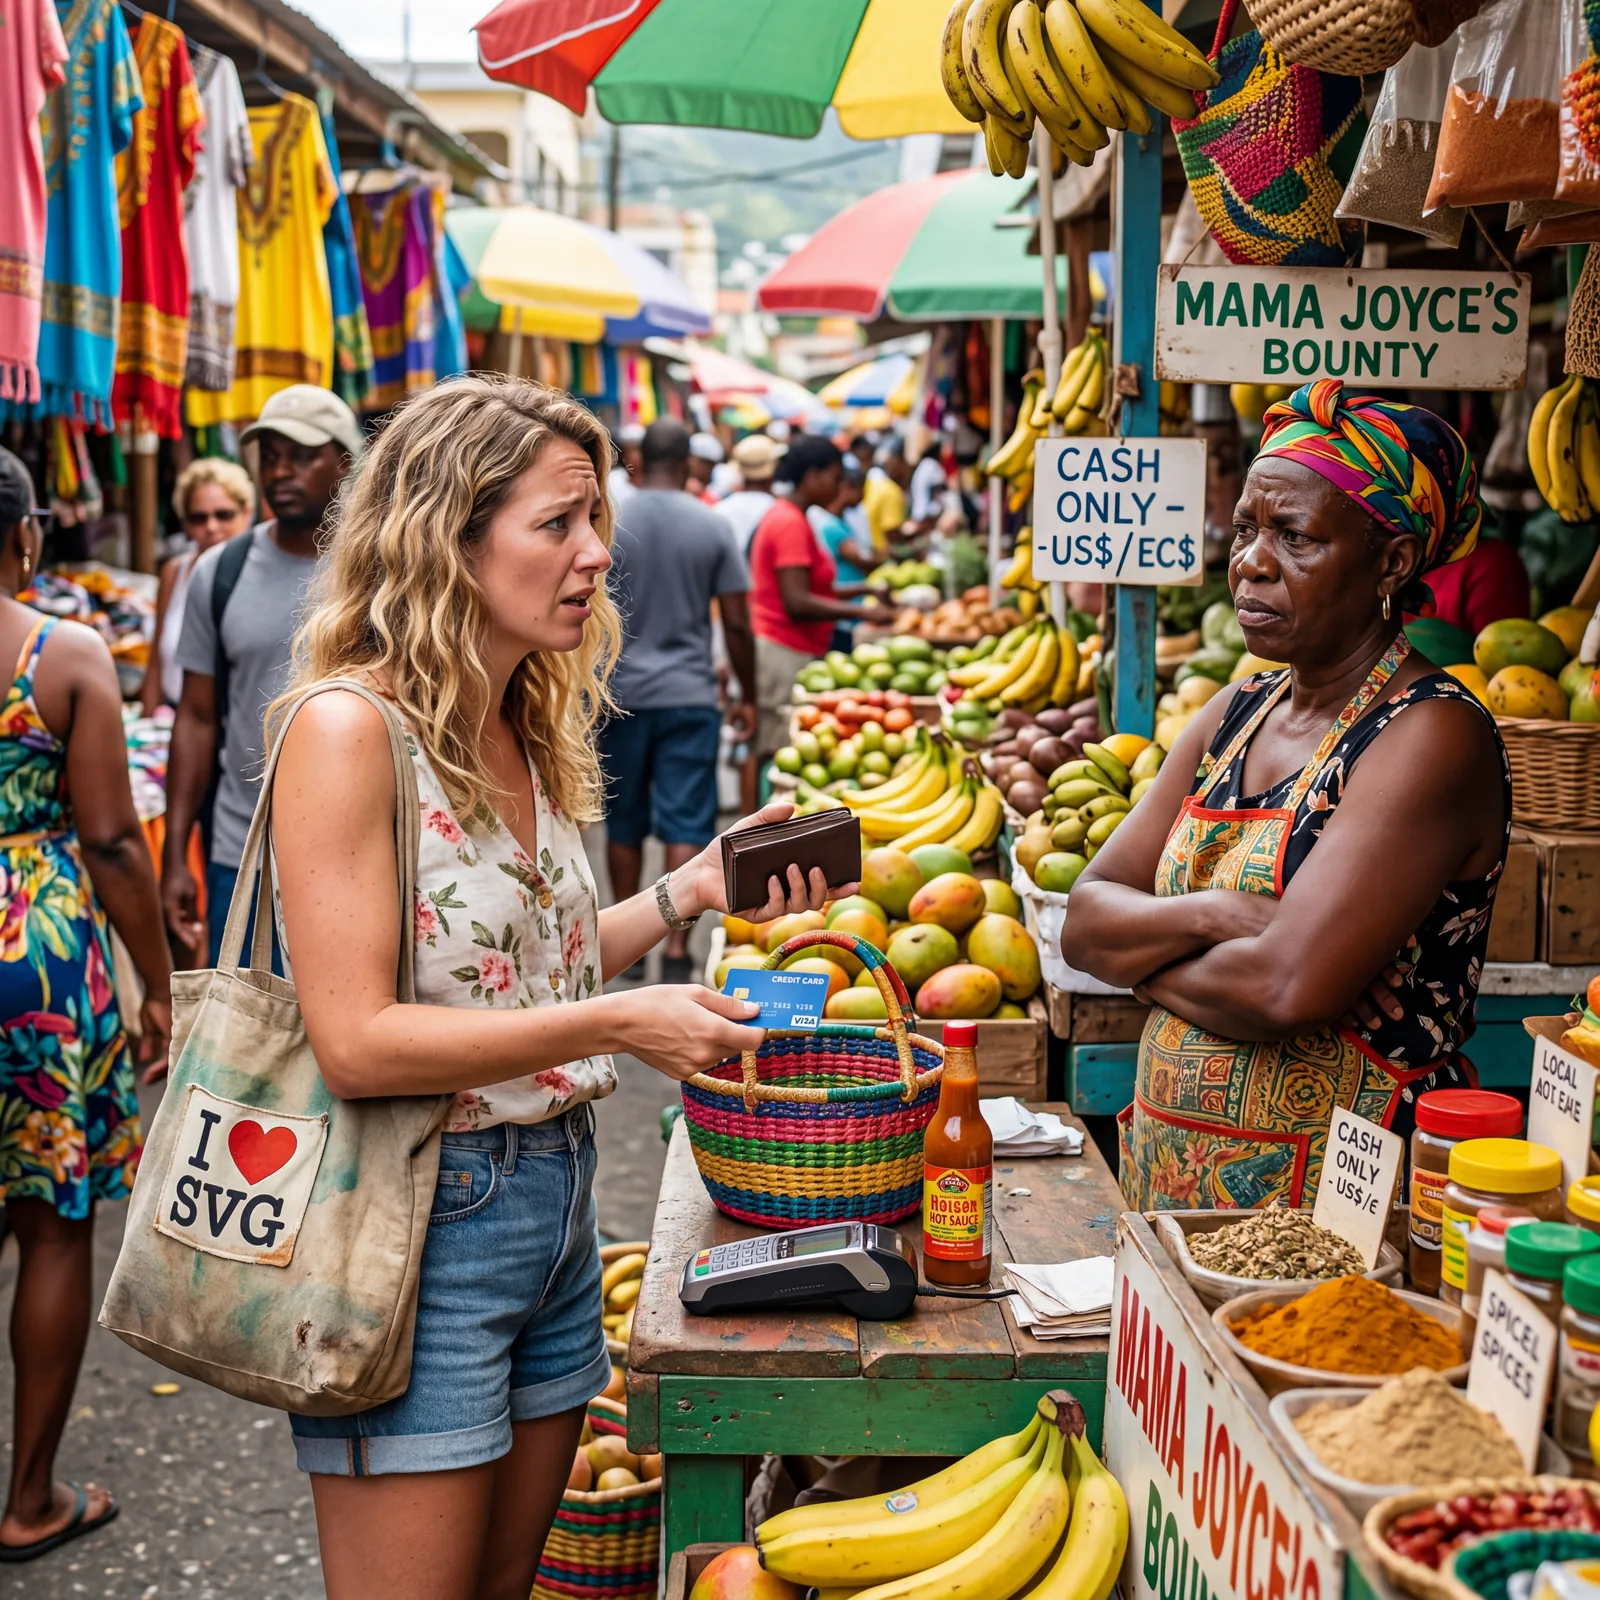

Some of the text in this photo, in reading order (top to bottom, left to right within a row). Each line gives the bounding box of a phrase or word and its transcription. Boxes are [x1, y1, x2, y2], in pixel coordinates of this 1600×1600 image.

[1176, 281, 1519, 335] MAMA JOYCE'S
[1263, 338, 1440, 379] BOUNTY
[1057, 447, 1160, 483] CASH
[1056, 491, 1156, 526] ONLY
[771, 975, 824, 985] CREDIT CARD
[1543, 1050, 1577, 1089] LOCAL
[188, 1109, 222, 1171] I
[1338, 1121, 1383, 1159] CASH
[1336, 1150, 1380, 1185] ONLY
[169, 1174, 285, 1248] SVG
[929, 1212, 979, 1226] HOT SAUCE
[1481, 1329, 1533, 1399] SPICES
[1115, 1274, 1320, 1600] MAMA JOYCE'
